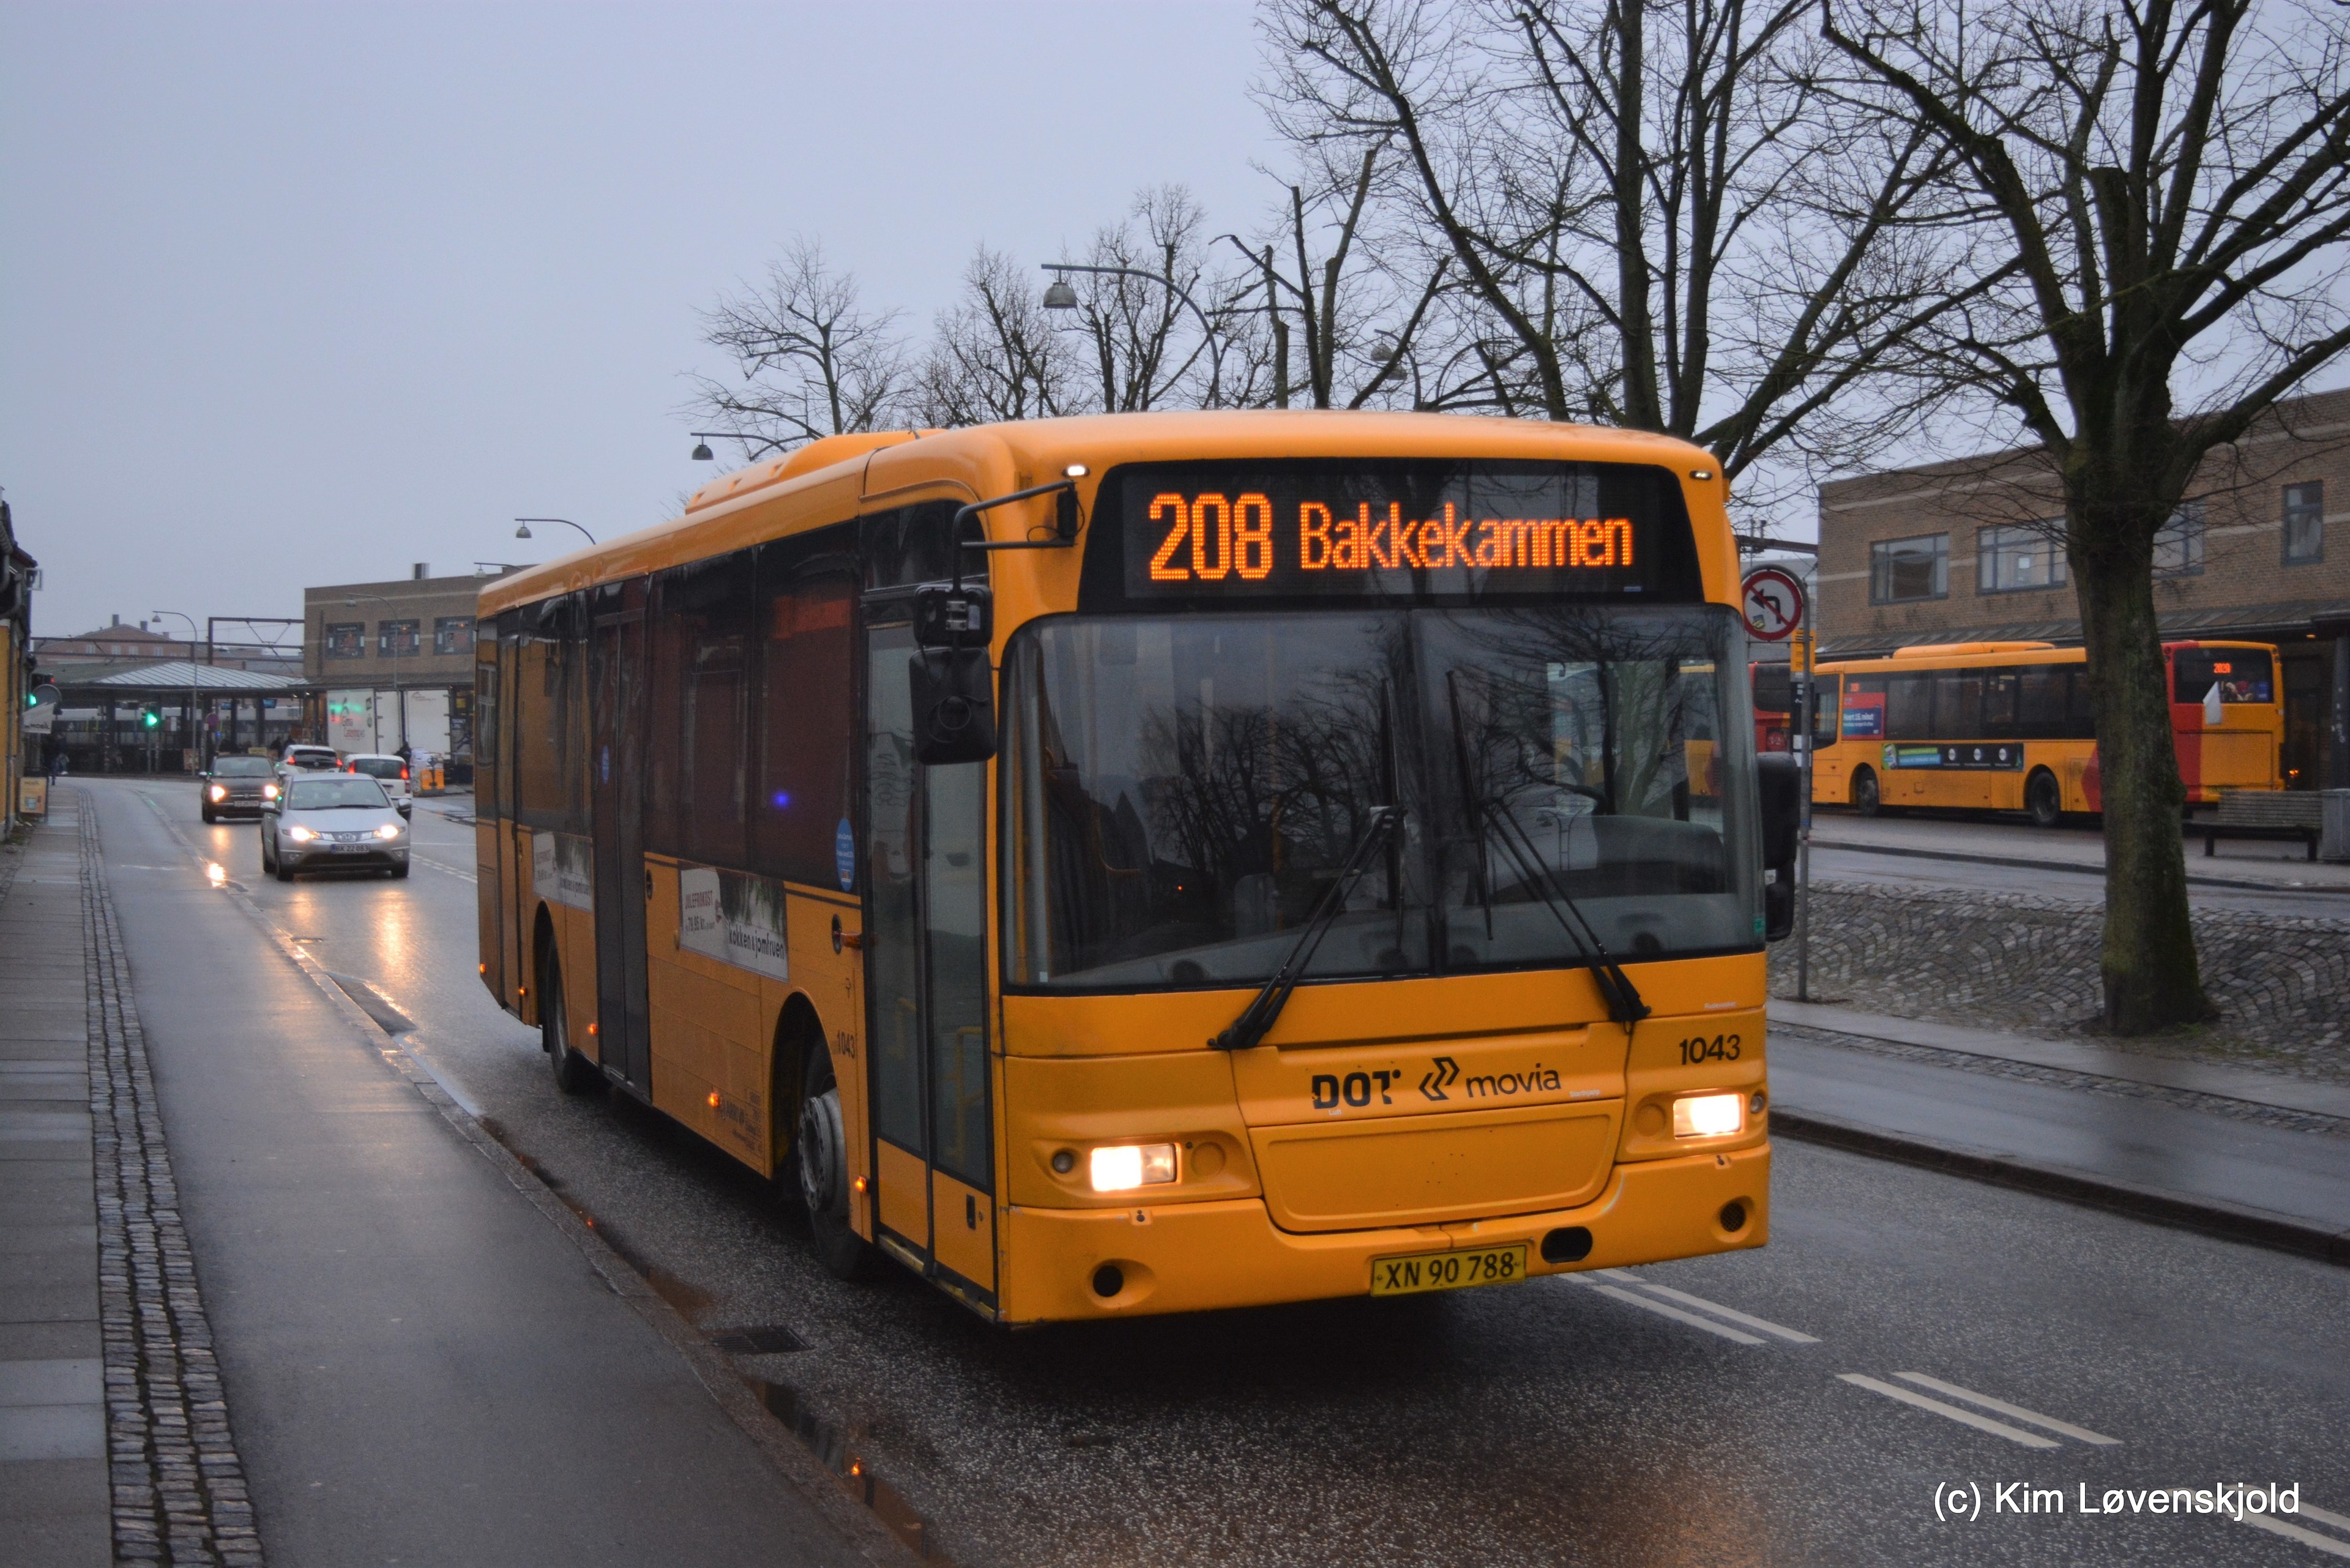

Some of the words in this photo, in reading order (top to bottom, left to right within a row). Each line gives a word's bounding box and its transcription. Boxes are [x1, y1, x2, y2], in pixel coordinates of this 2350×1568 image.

[1149, 492, 1274, 580] 208
[1300, 501, 1633, 569] Bakkekammen
[837, 1030, 856, 1059] 1043
[1679, 1034, 1740, 1065] 1043
[1311, 1069, 1401, 1109] DOT
[1465, 1062, 1562, 1098] movia
[1384, 1261, 1420, 1290] XN
[1428, 1258, 1459, 1285] 90
[1467, 1252, 1514, 1281] 788
